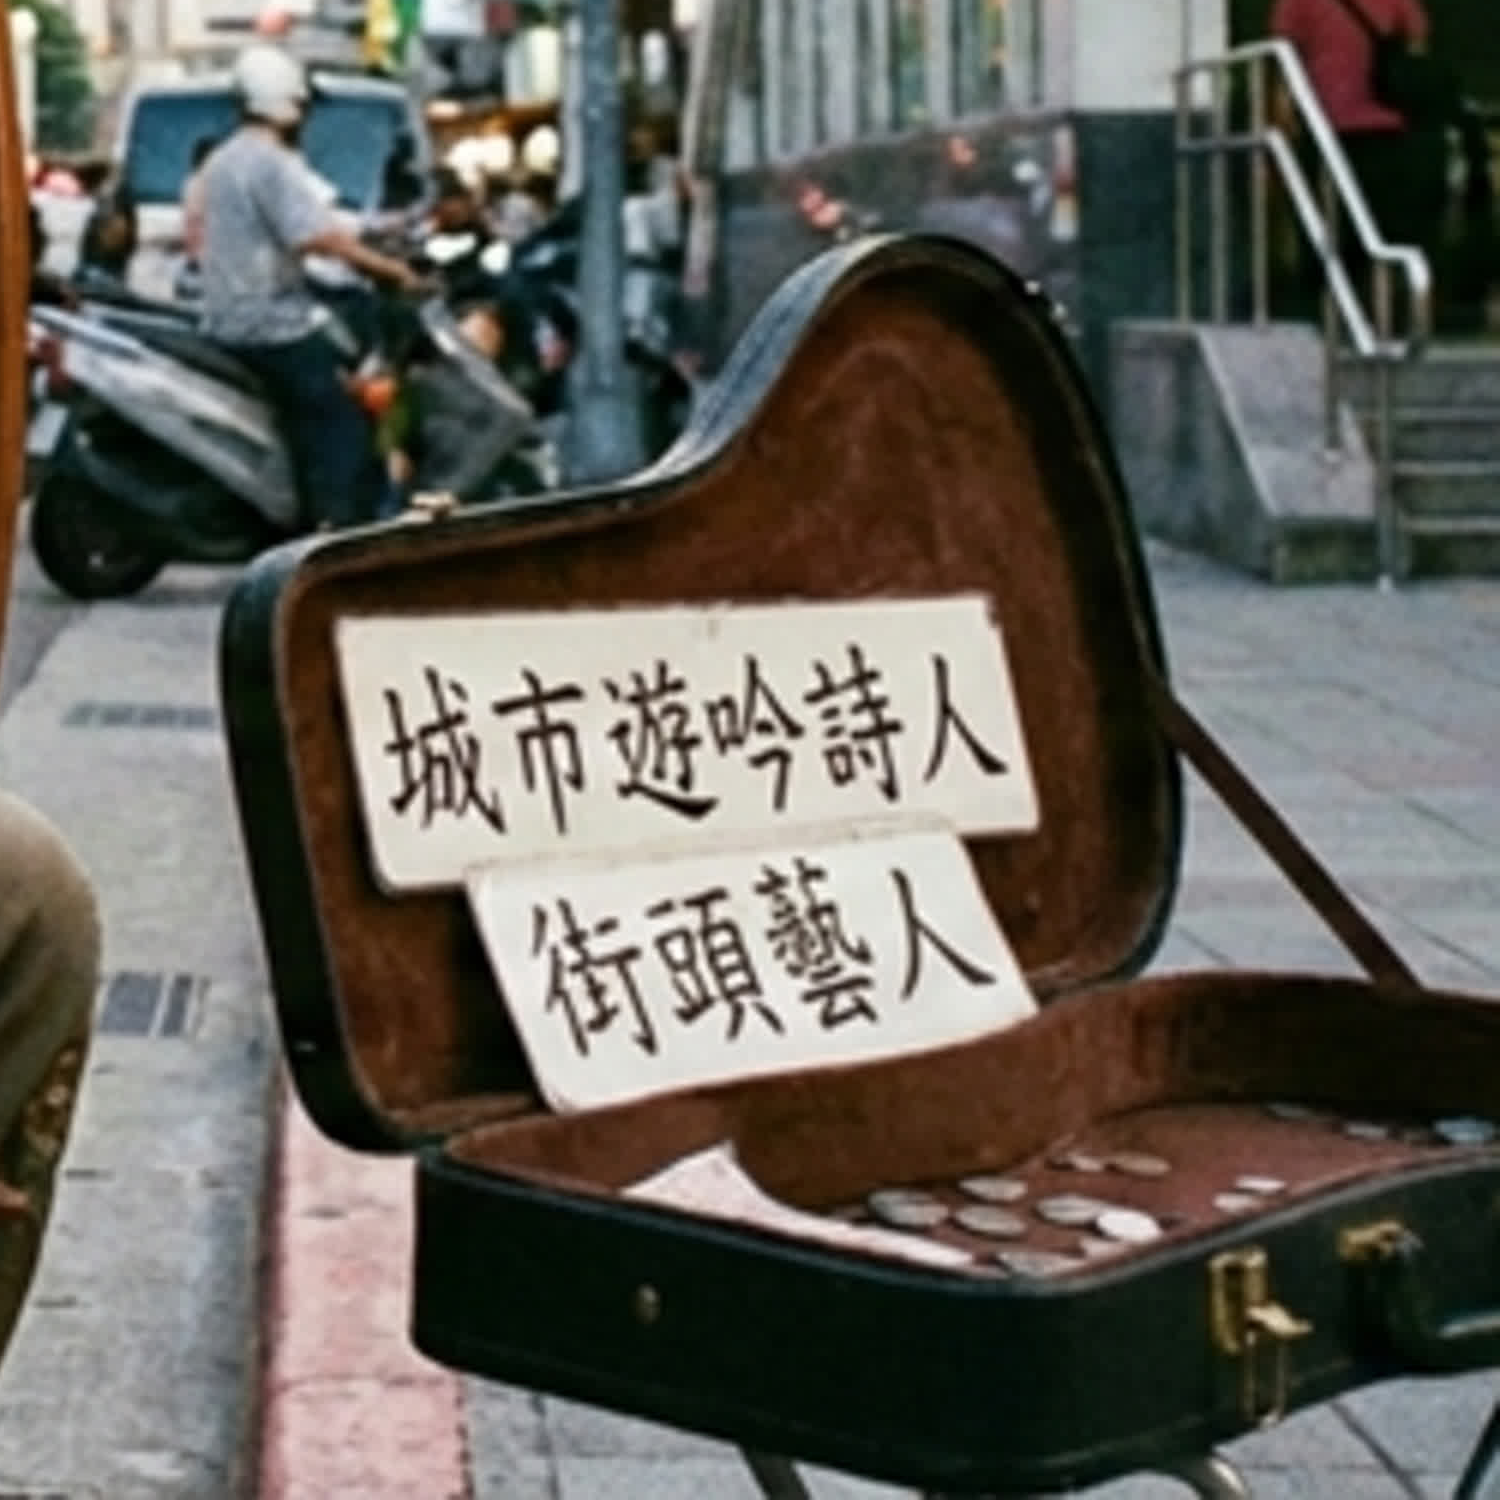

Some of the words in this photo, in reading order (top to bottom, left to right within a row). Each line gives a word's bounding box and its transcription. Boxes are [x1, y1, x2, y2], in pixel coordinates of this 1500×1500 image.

[383, 644, 1008, 835] 城市遊吟詩人
[531, 858, 996, 1057] 街頭藝人
